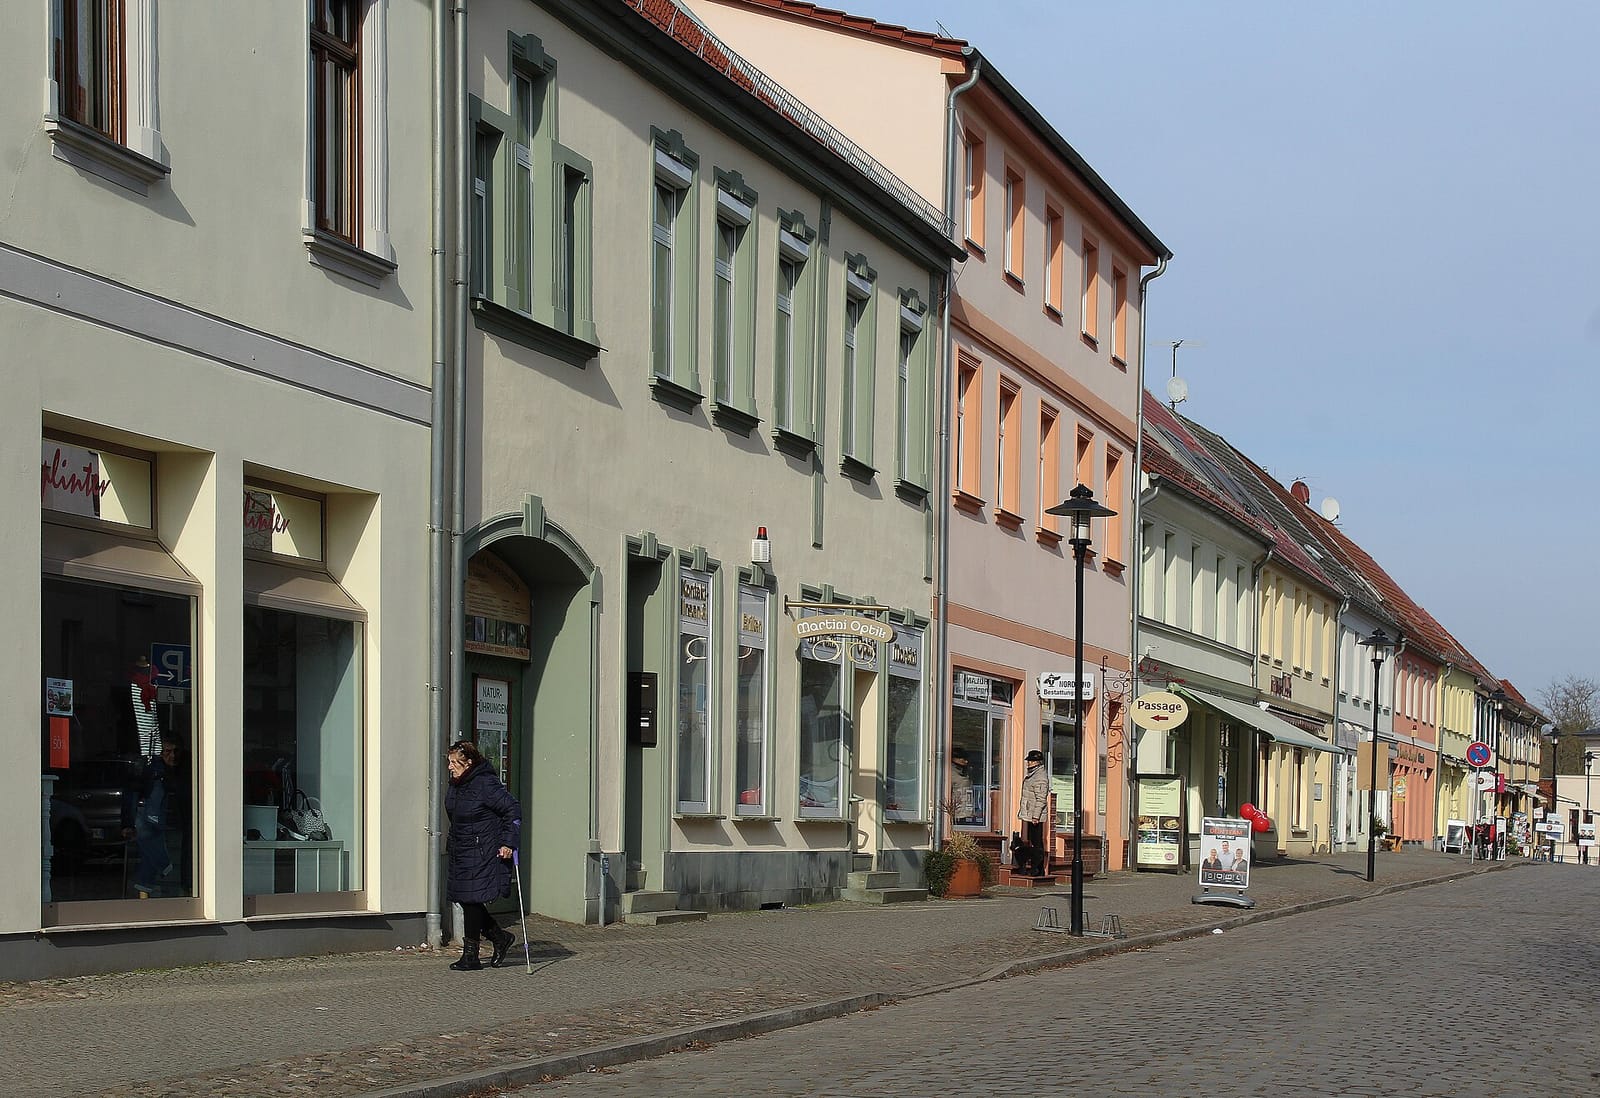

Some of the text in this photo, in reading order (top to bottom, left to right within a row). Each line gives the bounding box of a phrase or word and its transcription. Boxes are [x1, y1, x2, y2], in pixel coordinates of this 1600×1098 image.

[797, 619, 887, 639] Martini Optik
[1137, 700, 1182, 713] Passage
